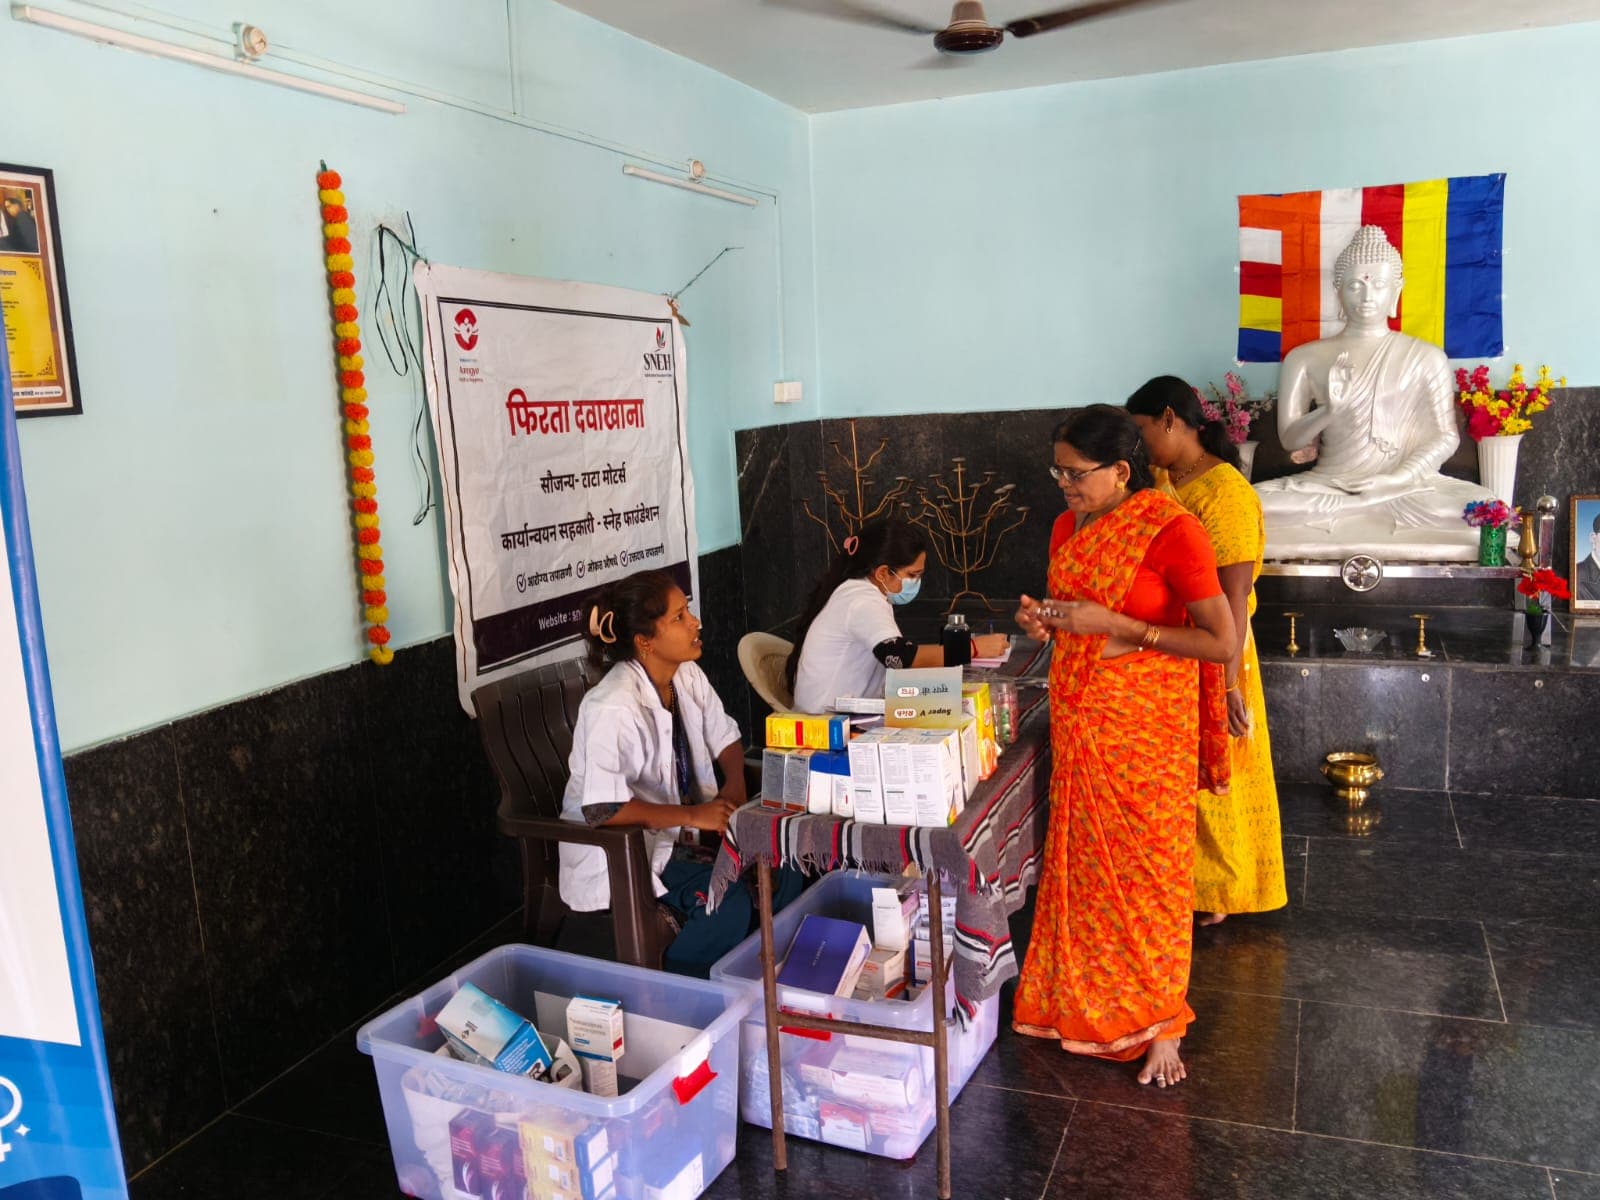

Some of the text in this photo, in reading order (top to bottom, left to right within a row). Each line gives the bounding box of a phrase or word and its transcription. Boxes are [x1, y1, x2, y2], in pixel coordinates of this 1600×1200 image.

[643, 353, 671, 371] SNEH
[505, 388, 645, 436] फिरता दवाखाना
[581, 470, 601, 489] टाटा
[602, 461, 626, 485] मोटर्स
[501, 522, 556, 551] कार्यान्वयन
[558, 511, 595, 541] सहकारी
[603, 507, 622, 532] स्नेह
[623, 502, 660, 527] फाउंडेशन
[538, 611, 568, 631] Website
[919, 709, 926, 717] V
[928, 707, 952, 716] Super
